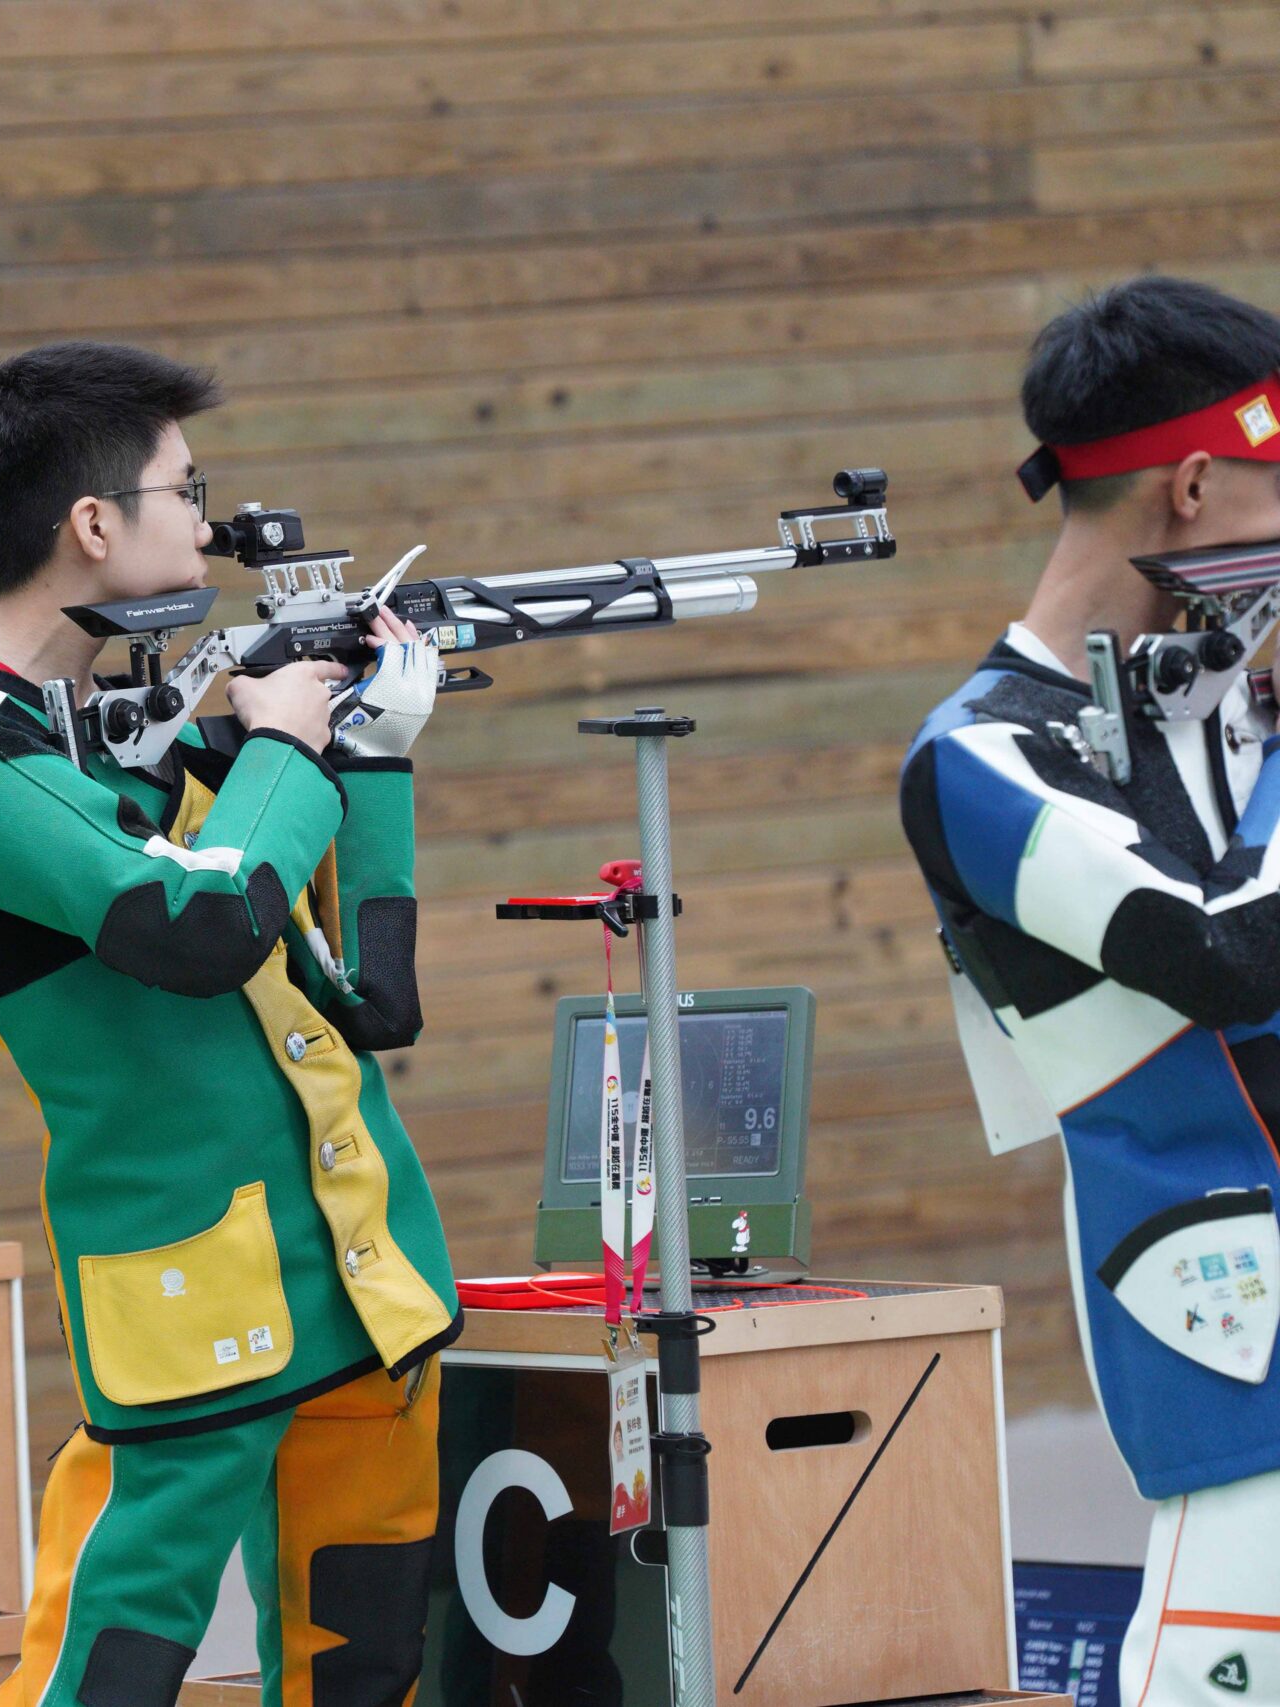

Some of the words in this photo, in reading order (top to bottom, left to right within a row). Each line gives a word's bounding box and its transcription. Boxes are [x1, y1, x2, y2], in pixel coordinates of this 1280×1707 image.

[126, 603, 195, 618] Feinwerkbau
[290, 623, 358, 634] Feinwerkbau
[744, 1107, 777, 1130] 9.6
[454, 1448, 577, 1657] C
